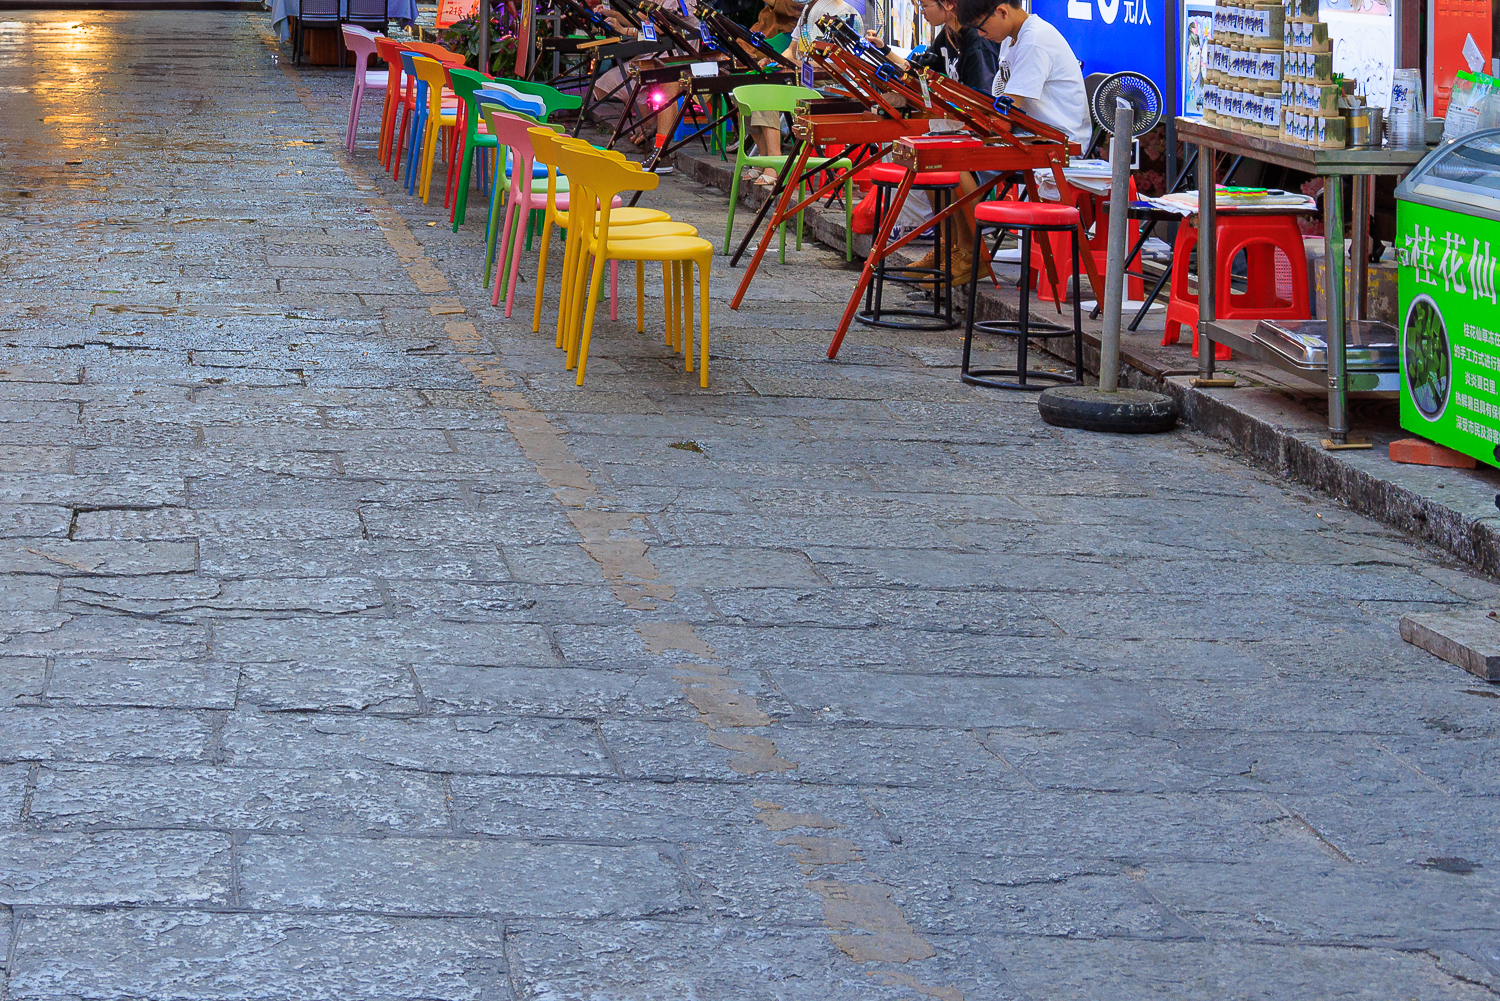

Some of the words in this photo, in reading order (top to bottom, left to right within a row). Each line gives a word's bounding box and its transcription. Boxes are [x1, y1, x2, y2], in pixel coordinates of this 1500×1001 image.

[1410, 223, 1497, 306] 桂花仙
[1455, 390, 1500, 421] 热解暑且具有保
[1456, 414, 1500, 445] 深受市民及游客
